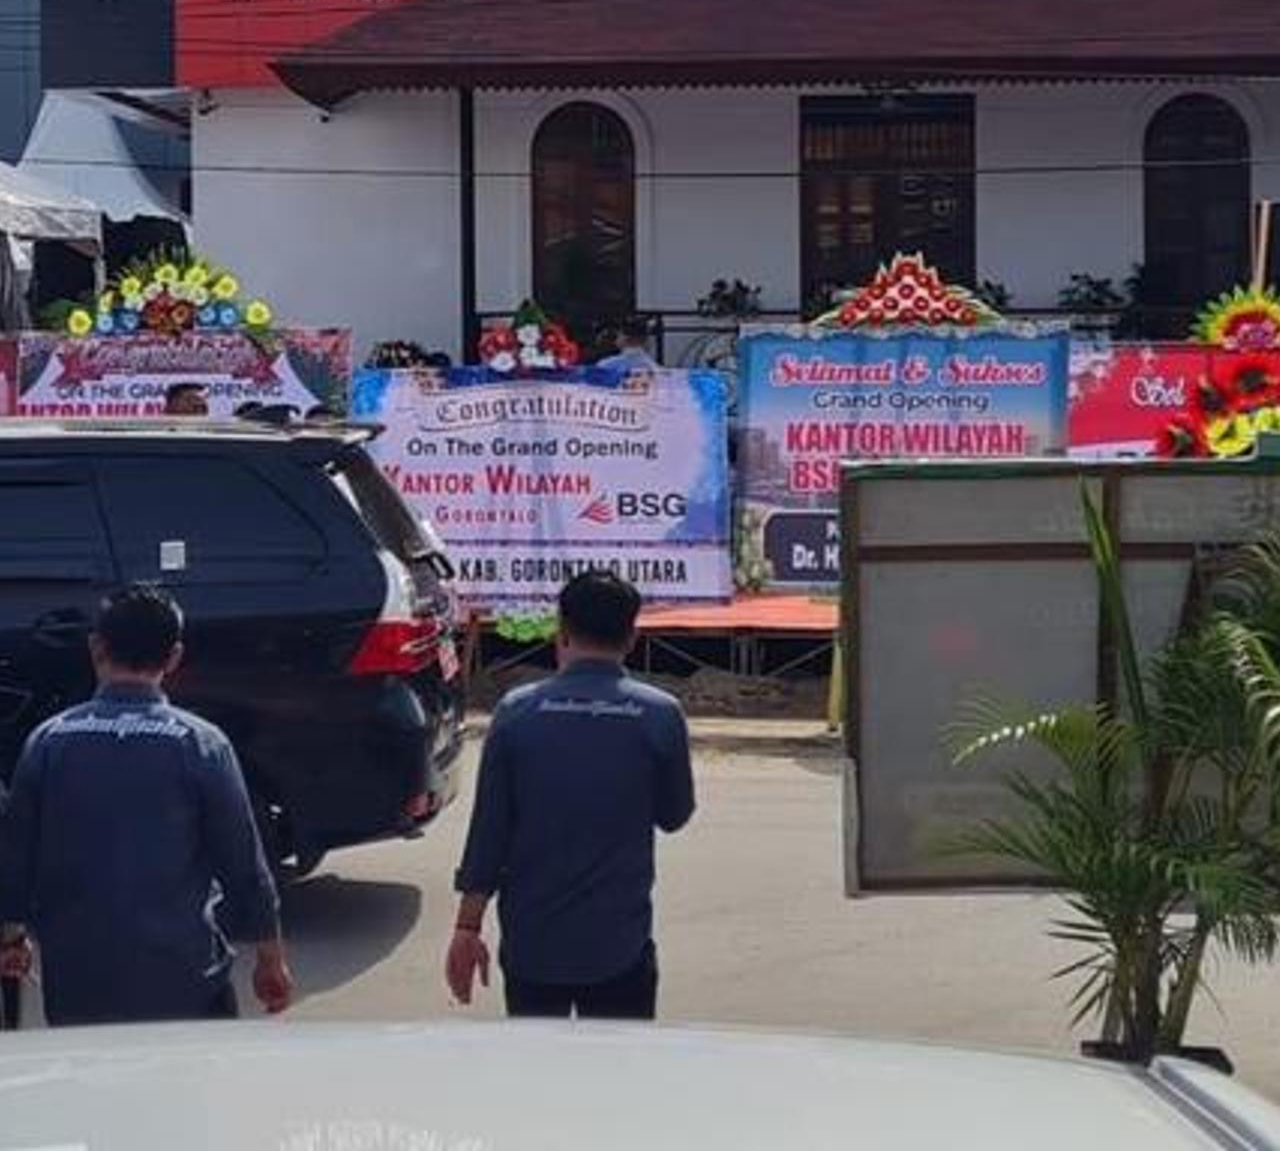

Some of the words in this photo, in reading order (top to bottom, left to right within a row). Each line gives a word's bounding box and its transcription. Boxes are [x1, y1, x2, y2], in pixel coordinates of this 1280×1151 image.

[772, 353, 897, 387] Selamat
[900, 354, 931, 386] &
[937, 353, 1047, 387] Sukses
[91, 382, 125, 398] THE
[813, 391, 883, 409] Grand
[888, 391, 990, 412] Opening
[435, 394, 638, 426] Congratulation
[406, 438, 437, 457] On
[445, 437, 484, 457] The
[490, 437, 558, 457] Grand
[564, 437, 659, 460] Opening
[786, 421, 898, 455] KANTOR
[902, 420, 1026, 455] WILAYAH
[485, 463, 591, 495] WILAYAH
[435, 505, 538, 525] GORONTALO
[617, 492, 688, 518] BSG
[460, 558, 504, 583] KAB.
[627, 558, 688, 583] UTARA
[792, 544, 819, 570] Dr.
